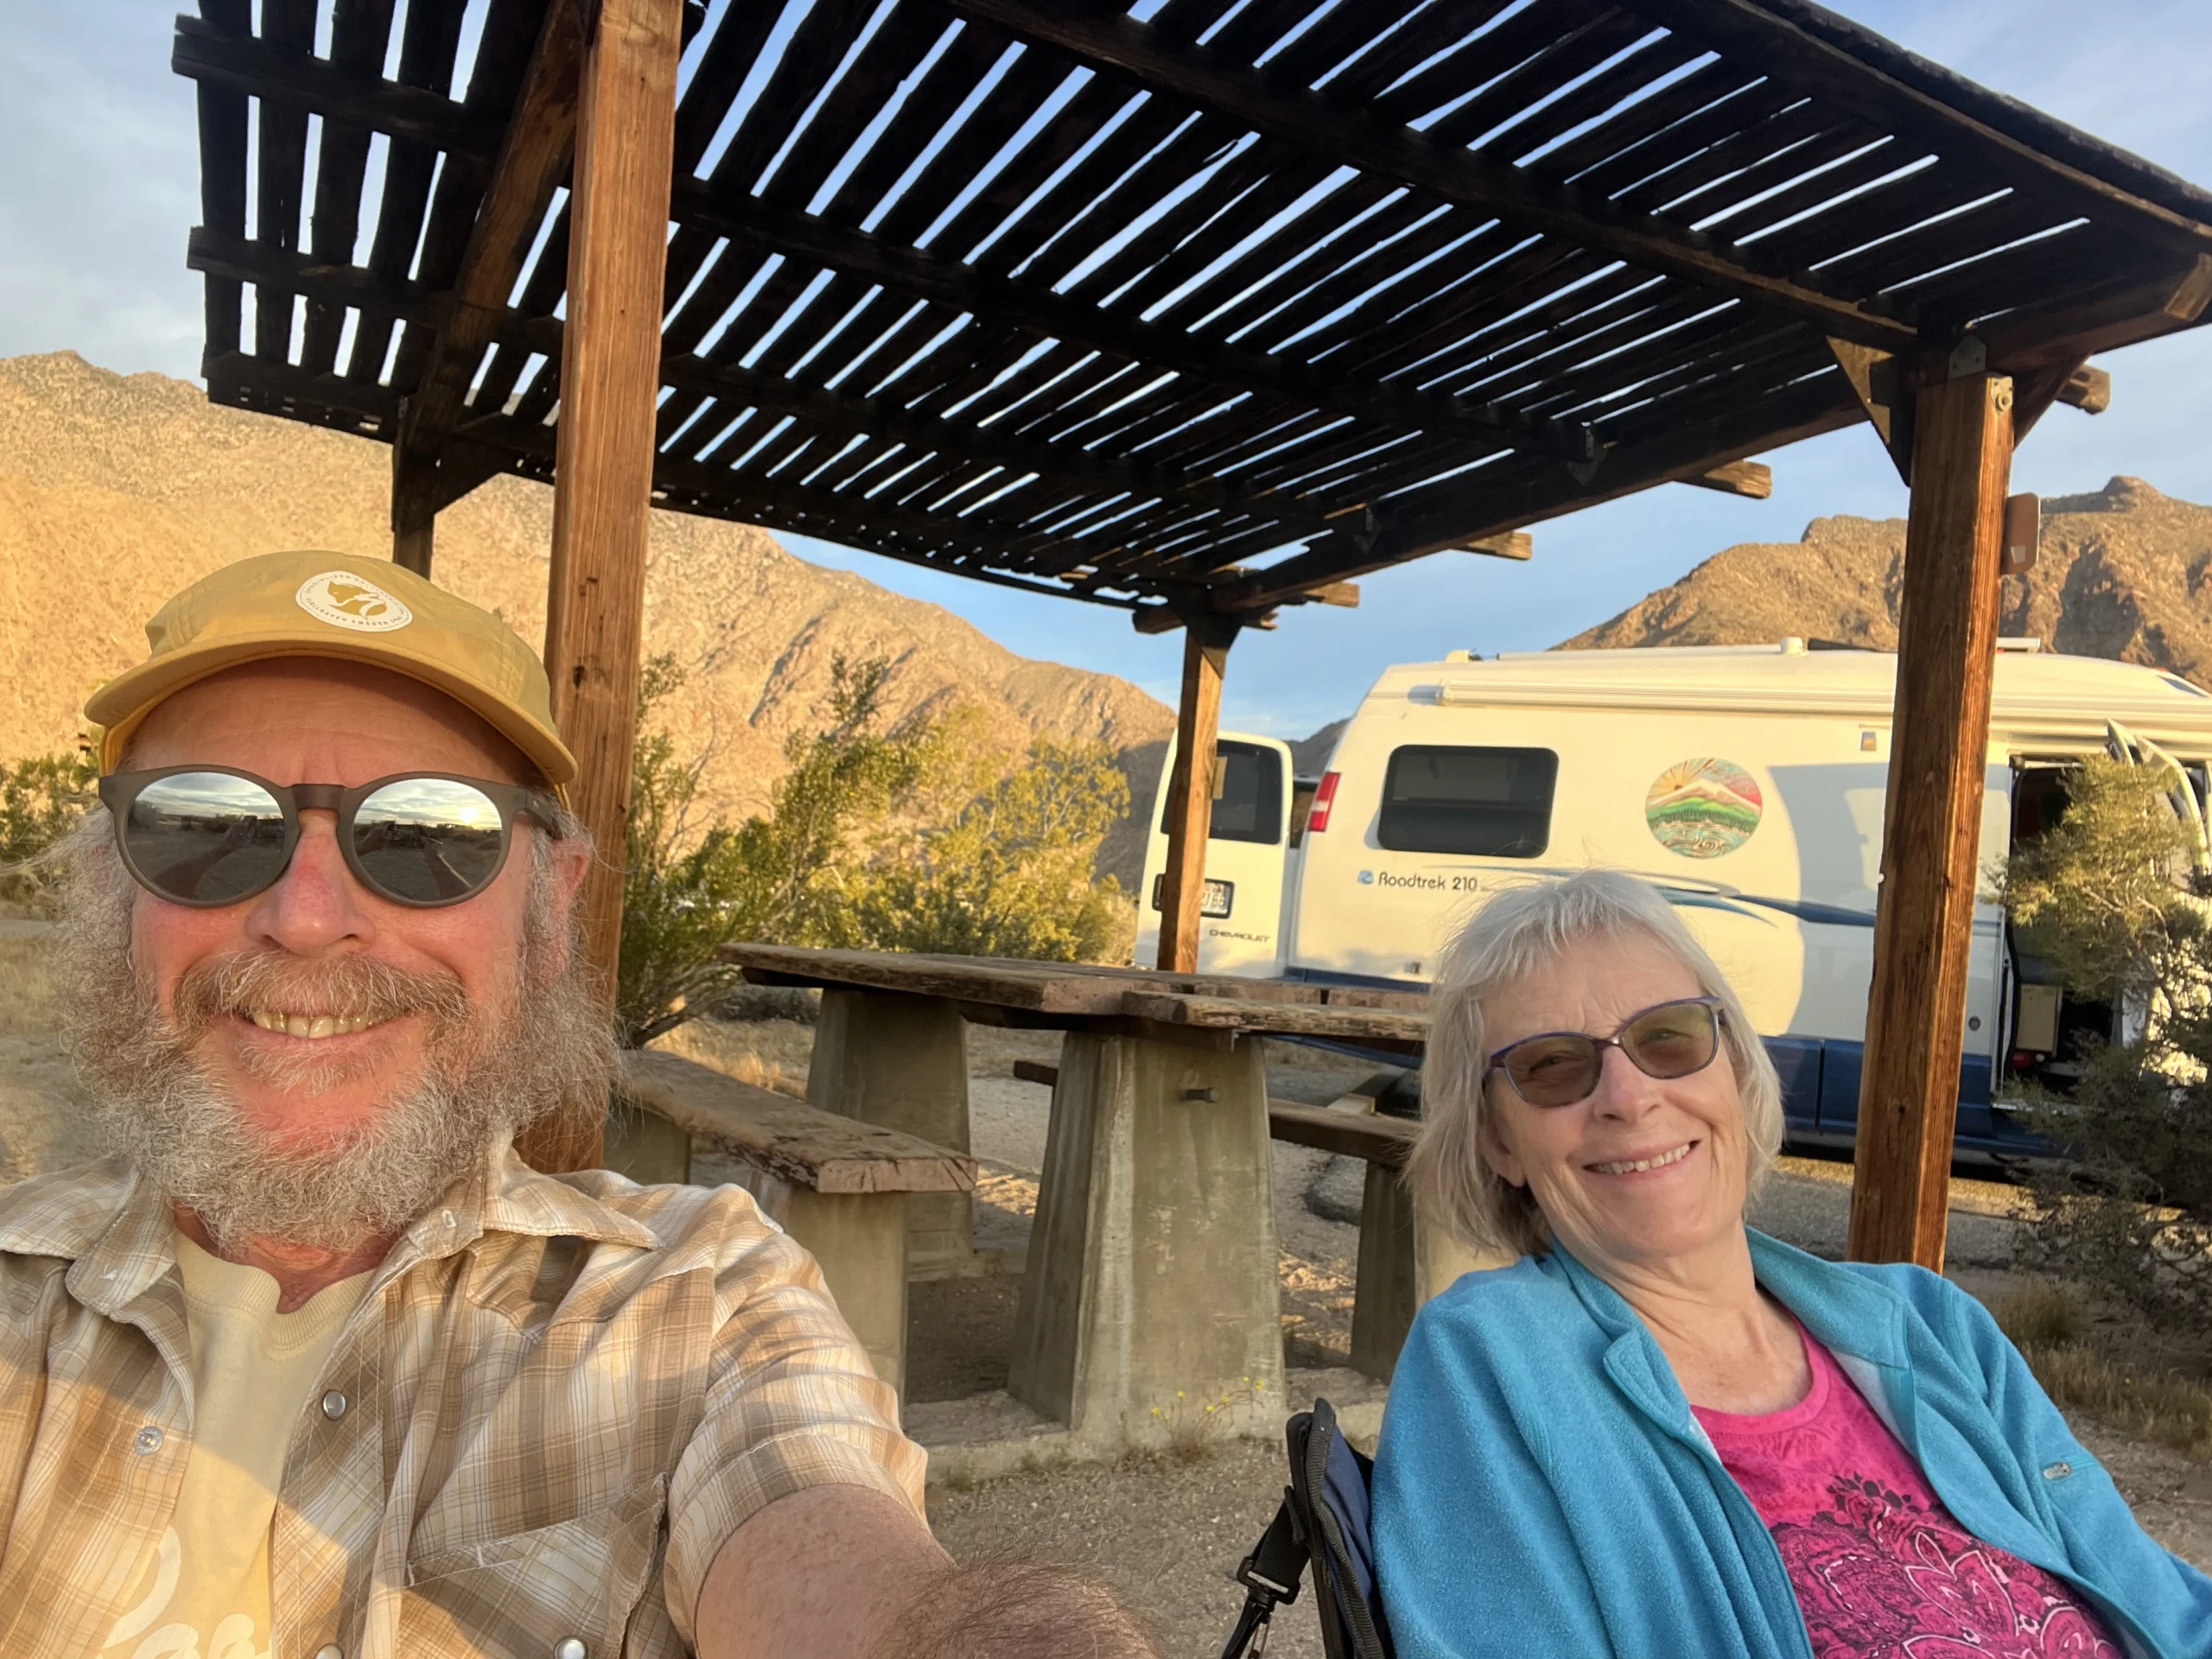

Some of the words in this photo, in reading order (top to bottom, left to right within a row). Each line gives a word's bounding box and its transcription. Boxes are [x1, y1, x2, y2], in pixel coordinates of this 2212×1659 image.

[1378, 871, 1446, 890] Roadtrek
[1452, 876, 1478, 891] 210
[1209, 929, 1270, 943] CHEVROLET
